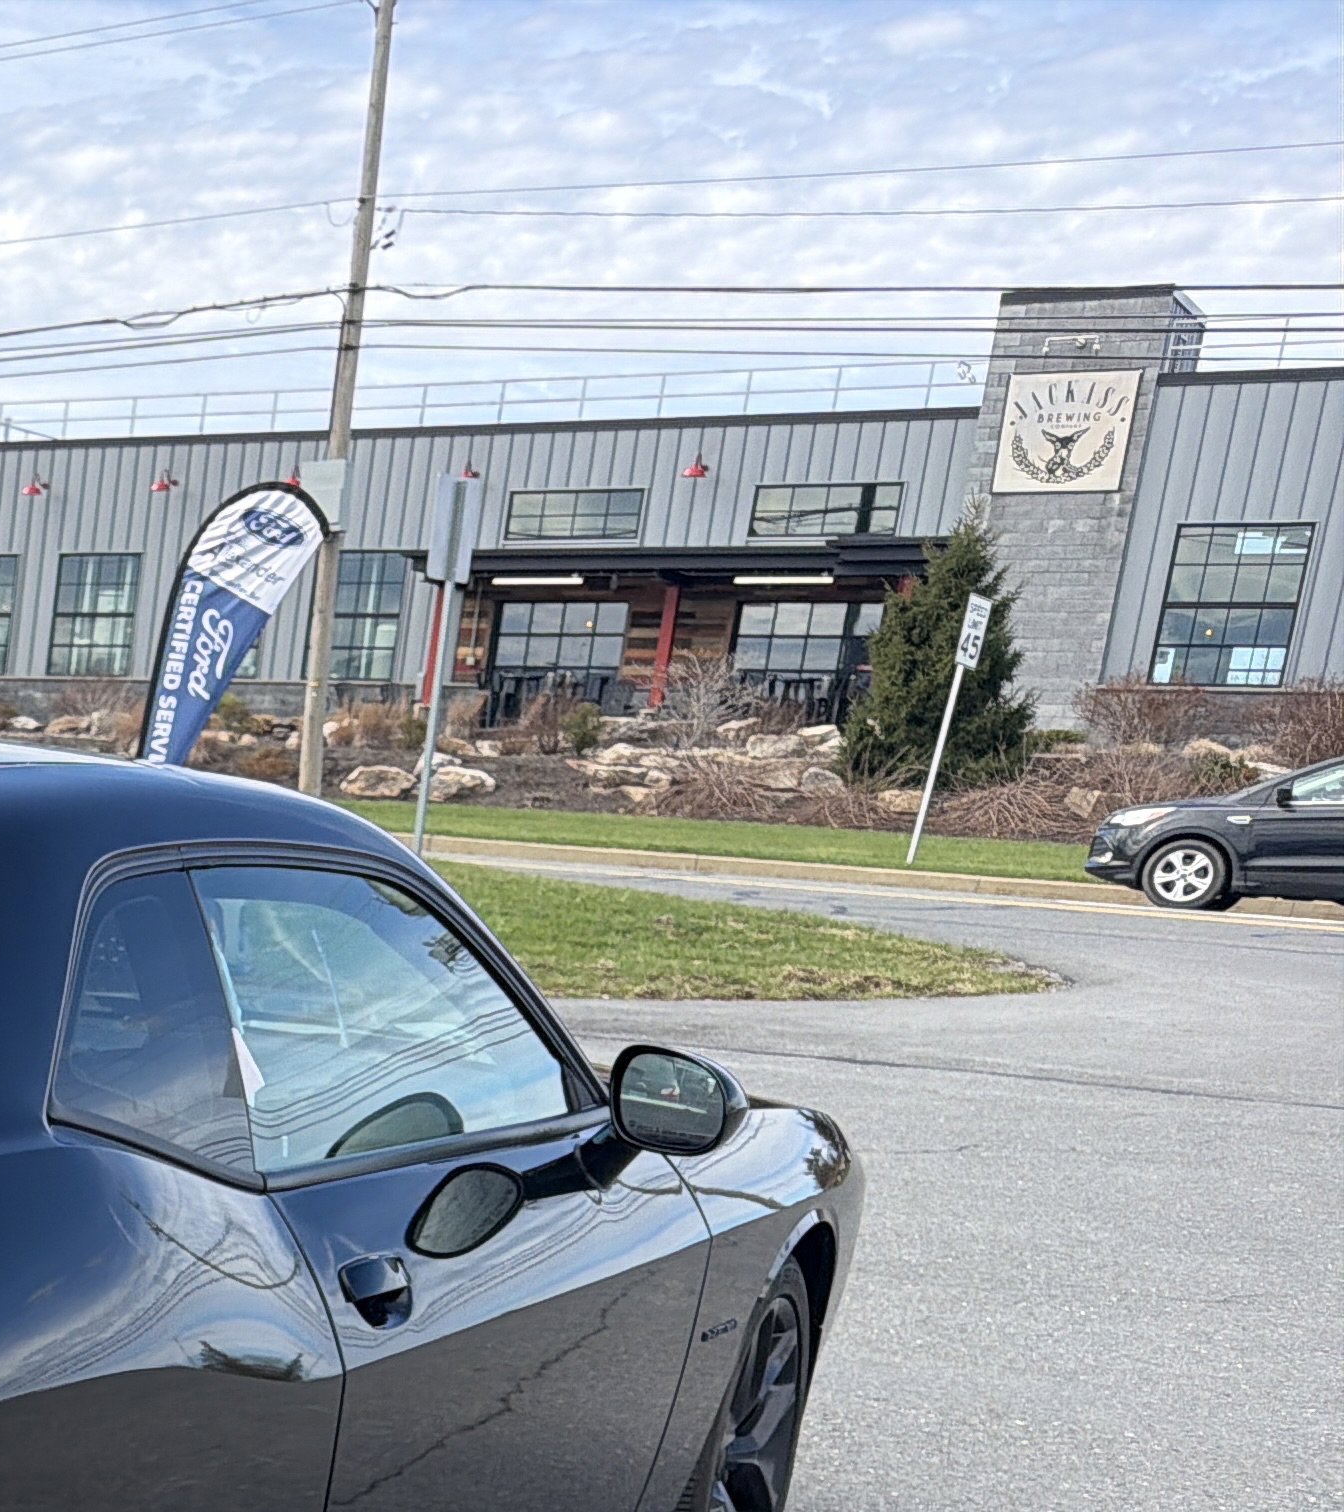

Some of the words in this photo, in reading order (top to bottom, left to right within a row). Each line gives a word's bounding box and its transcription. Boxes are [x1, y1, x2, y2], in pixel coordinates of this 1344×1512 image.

[1037, 412, 1102, 424] BREWING
[163, 580, 203, 691] CERTIFIED
[187, 608, 234, 701] Ford
[961, 633, 980, 660] 45
